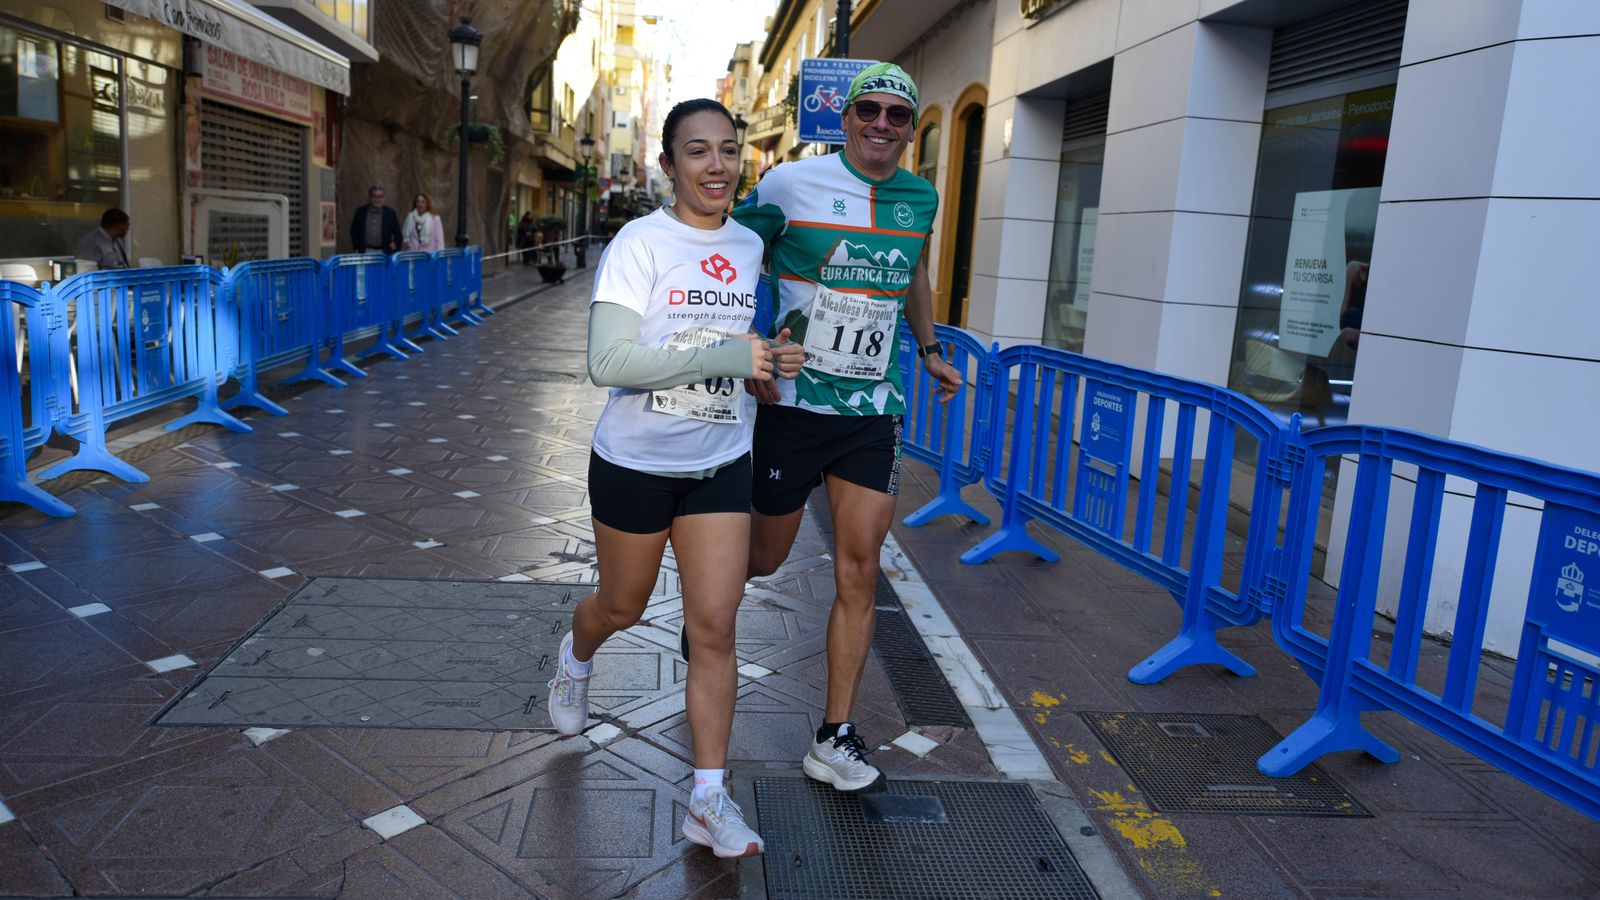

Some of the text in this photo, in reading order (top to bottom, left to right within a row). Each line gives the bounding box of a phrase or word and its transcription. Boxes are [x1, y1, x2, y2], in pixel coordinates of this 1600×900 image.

[804, 67, 836, 76] PROHIBIDO
[1294, 258, 1328, 269] RENUEVA
[820, 266, 883, 283] EURAFRICA
[1293, 271, 1334, 284] TU SONRISA
[849, 297, 870, 306] Carrera
[667, 311, 710, 322] strength
[828, 325, 885, 358] 118
[1093, 396, 1123, 413] DEPORTES
[1564, 535, 1600, 557] DEP
